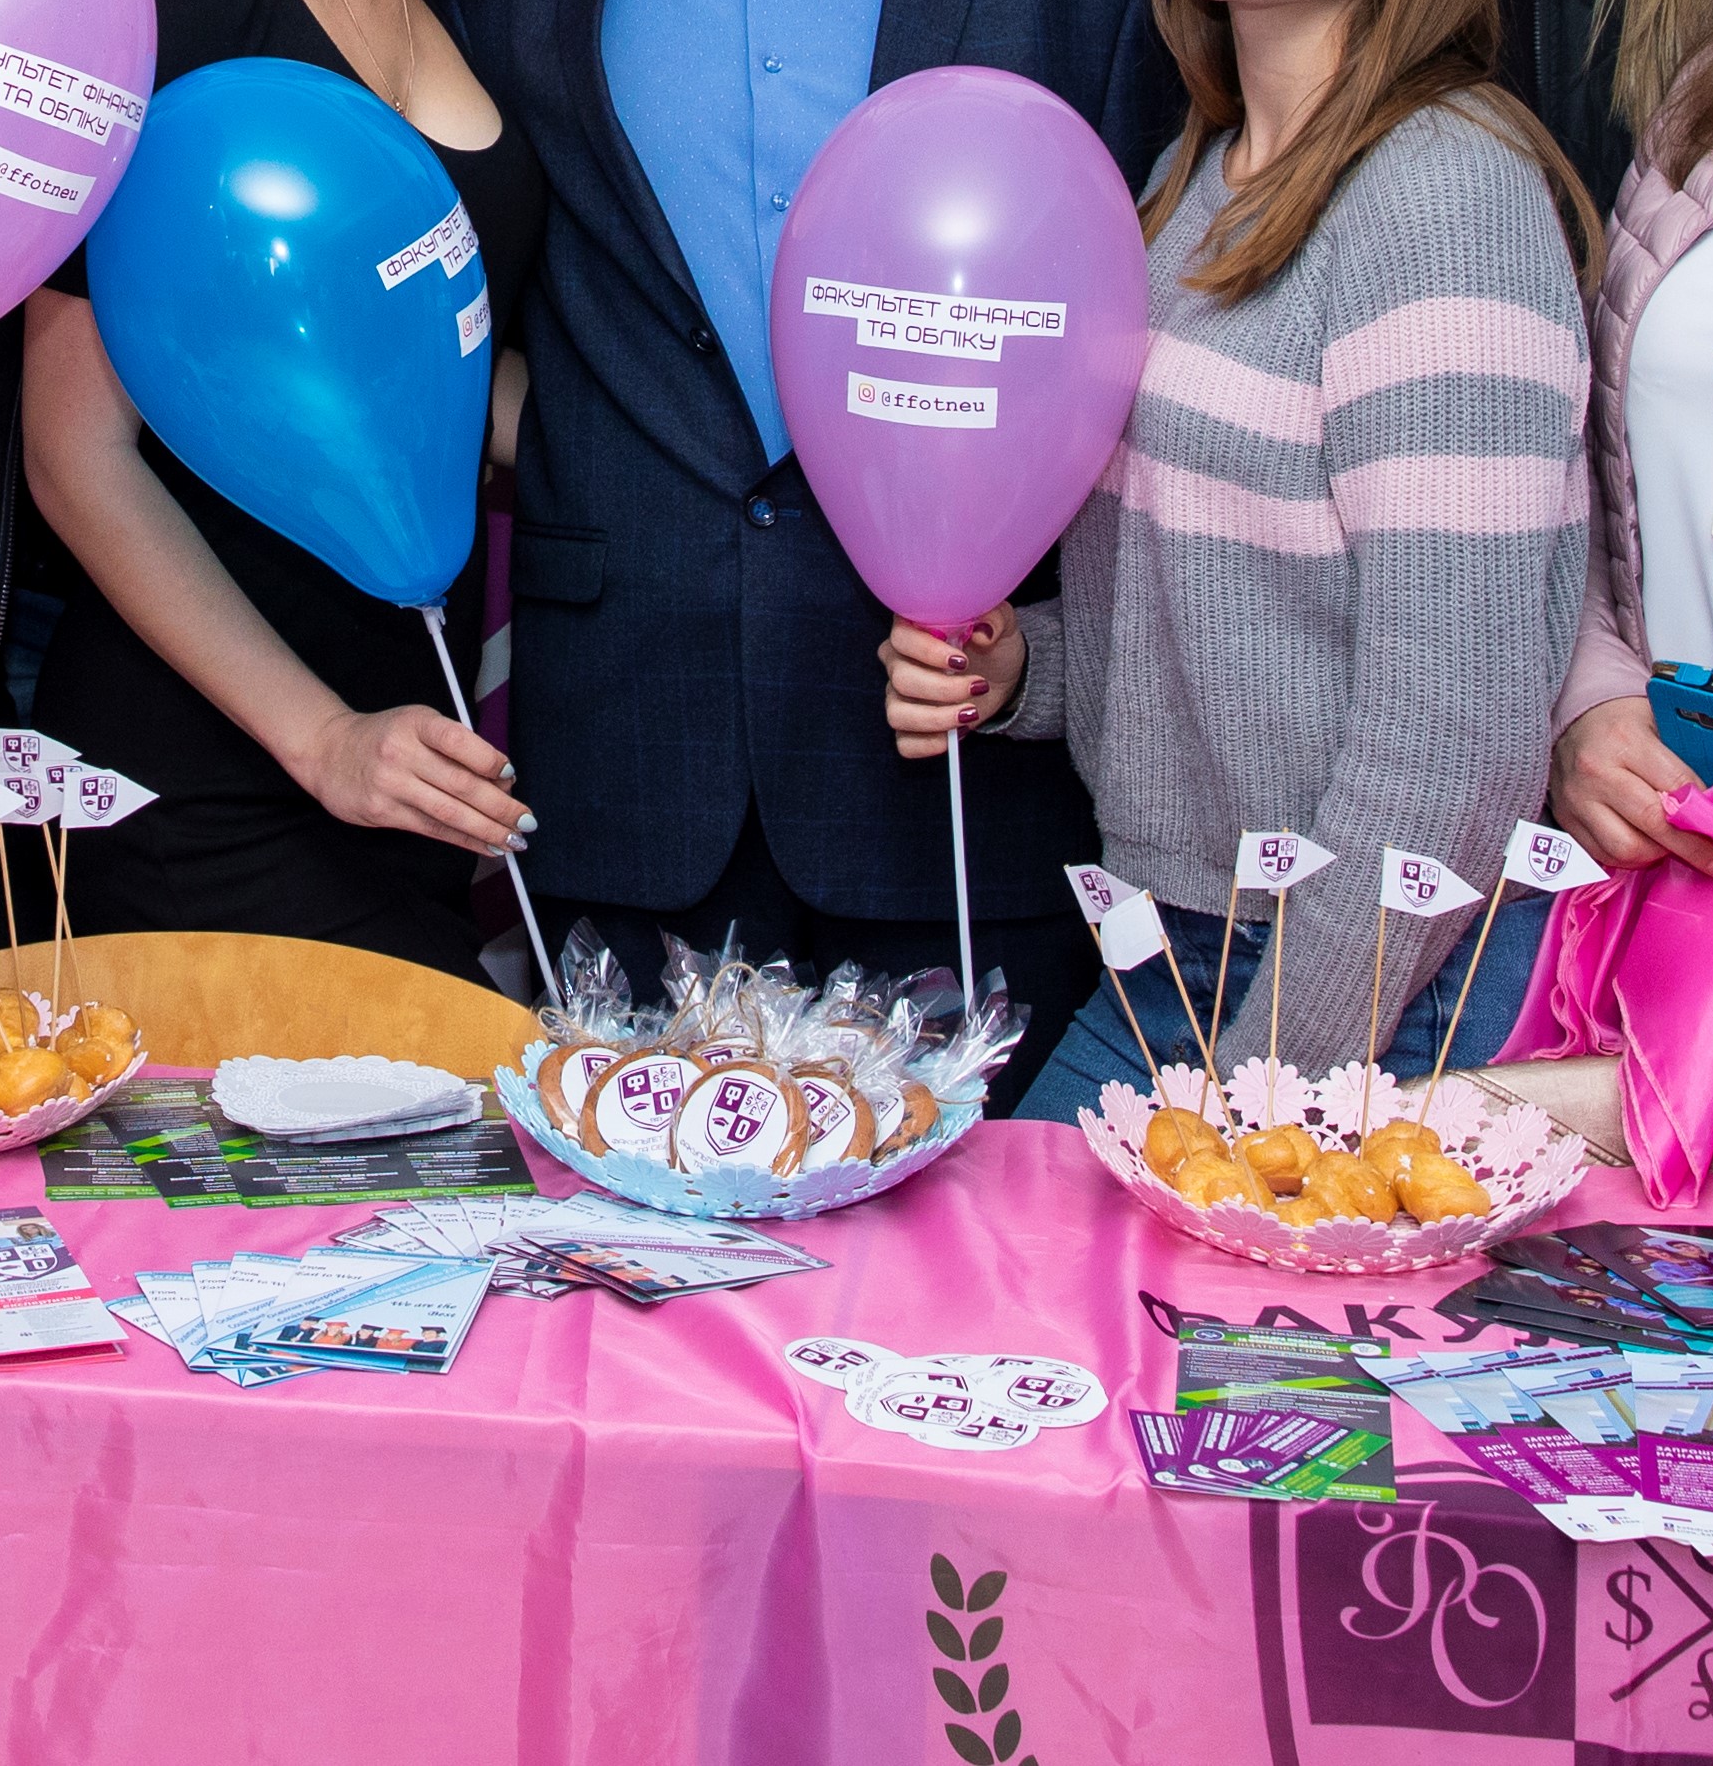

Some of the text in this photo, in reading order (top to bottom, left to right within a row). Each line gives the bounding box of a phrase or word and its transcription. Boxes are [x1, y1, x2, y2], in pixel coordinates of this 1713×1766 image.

[2, 82, 109, 137] ТА ОБЛІКУ
[443, 245, 463, 268] ТА
[812, 284, 1061, 330] ФАКУЛЬТЕТ ФІНАНСІВ
[866, 319, 996, 351] ТА ОБЛІКУ
[881, 391, 985, 413] @ffotneu
[1656, 1451, 1674, 1459] НА
